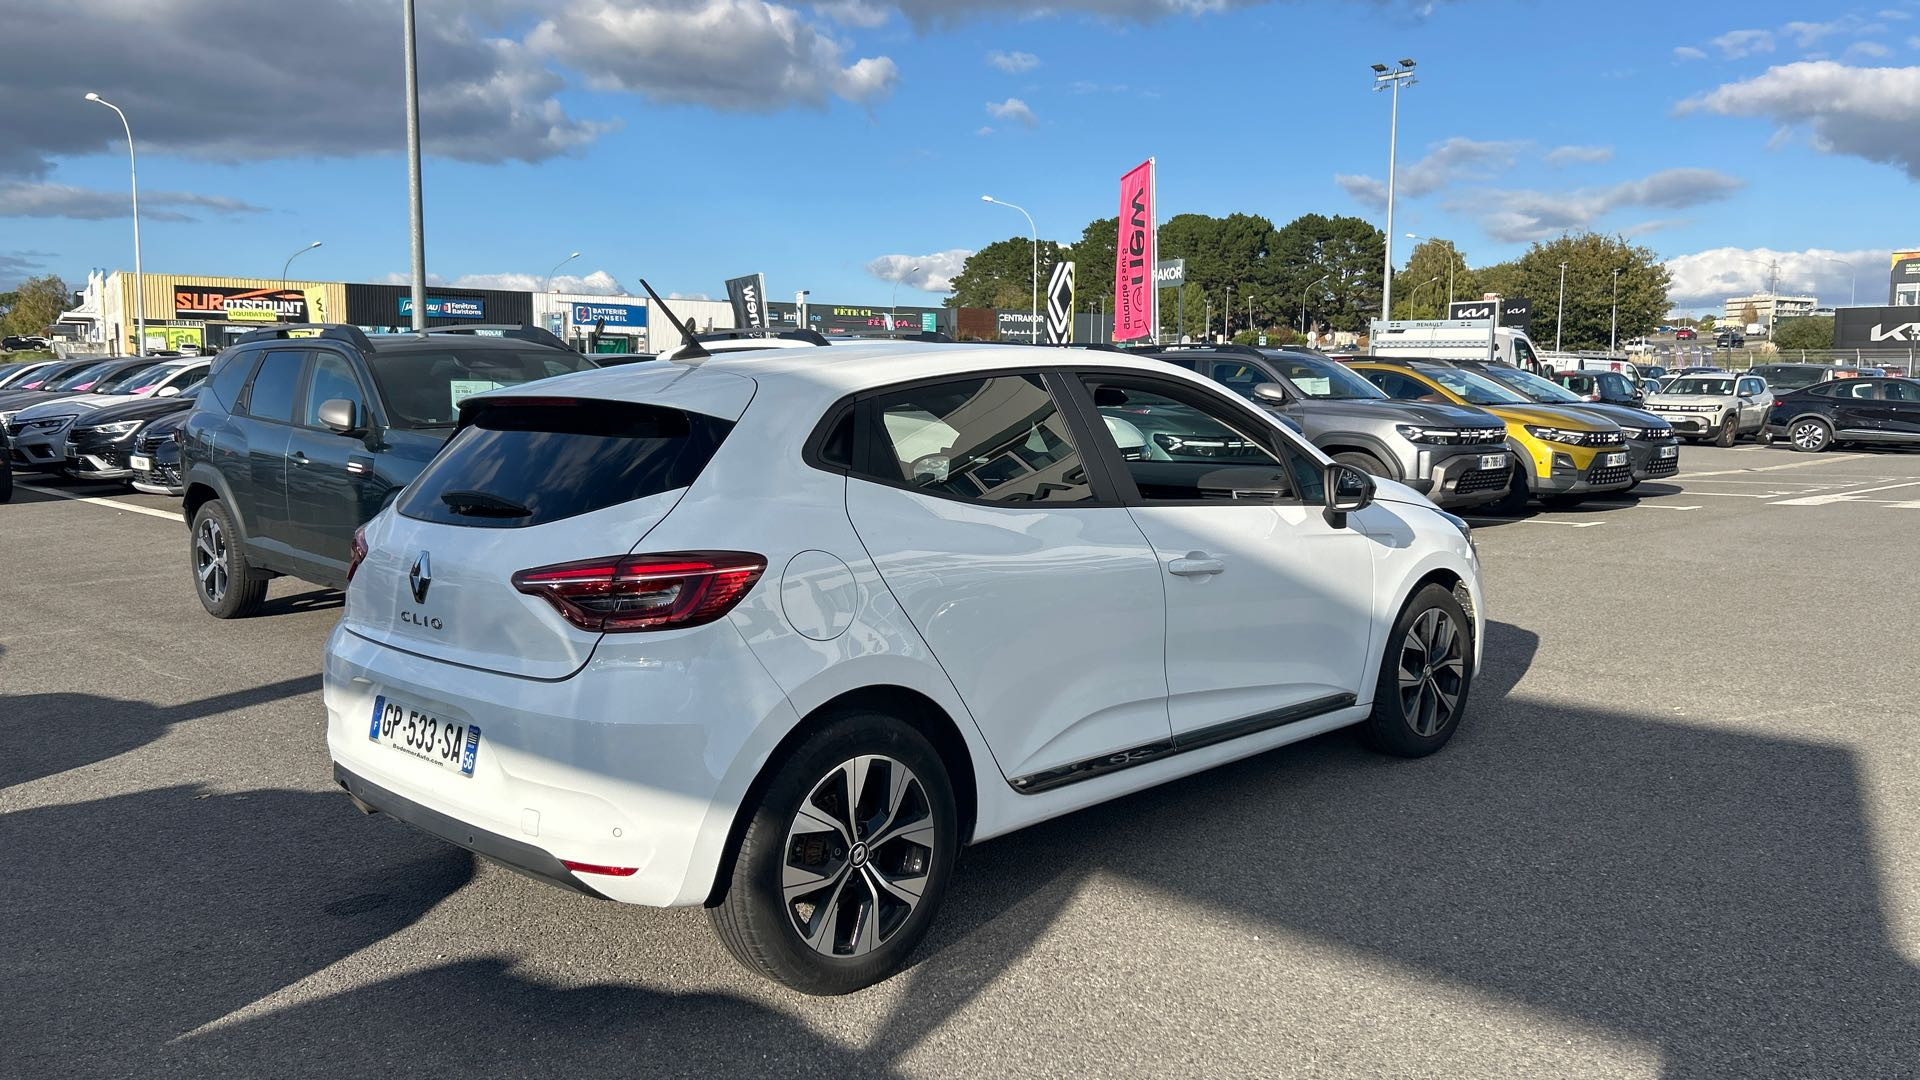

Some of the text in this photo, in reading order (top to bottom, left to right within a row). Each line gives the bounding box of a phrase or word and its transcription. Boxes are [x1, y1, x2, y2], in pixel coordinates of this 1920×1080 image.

[228, 310, 277, 319] LIQUIDATION
[592, 307, 627, 316] BATTERIES
[999, 313, 1044, 324] CENTRAKOR
[400, 611, 443, 630] CLIO
[373, 702, 463, 764] F GP-533-SA
[463, 751, 474, 770] 56
